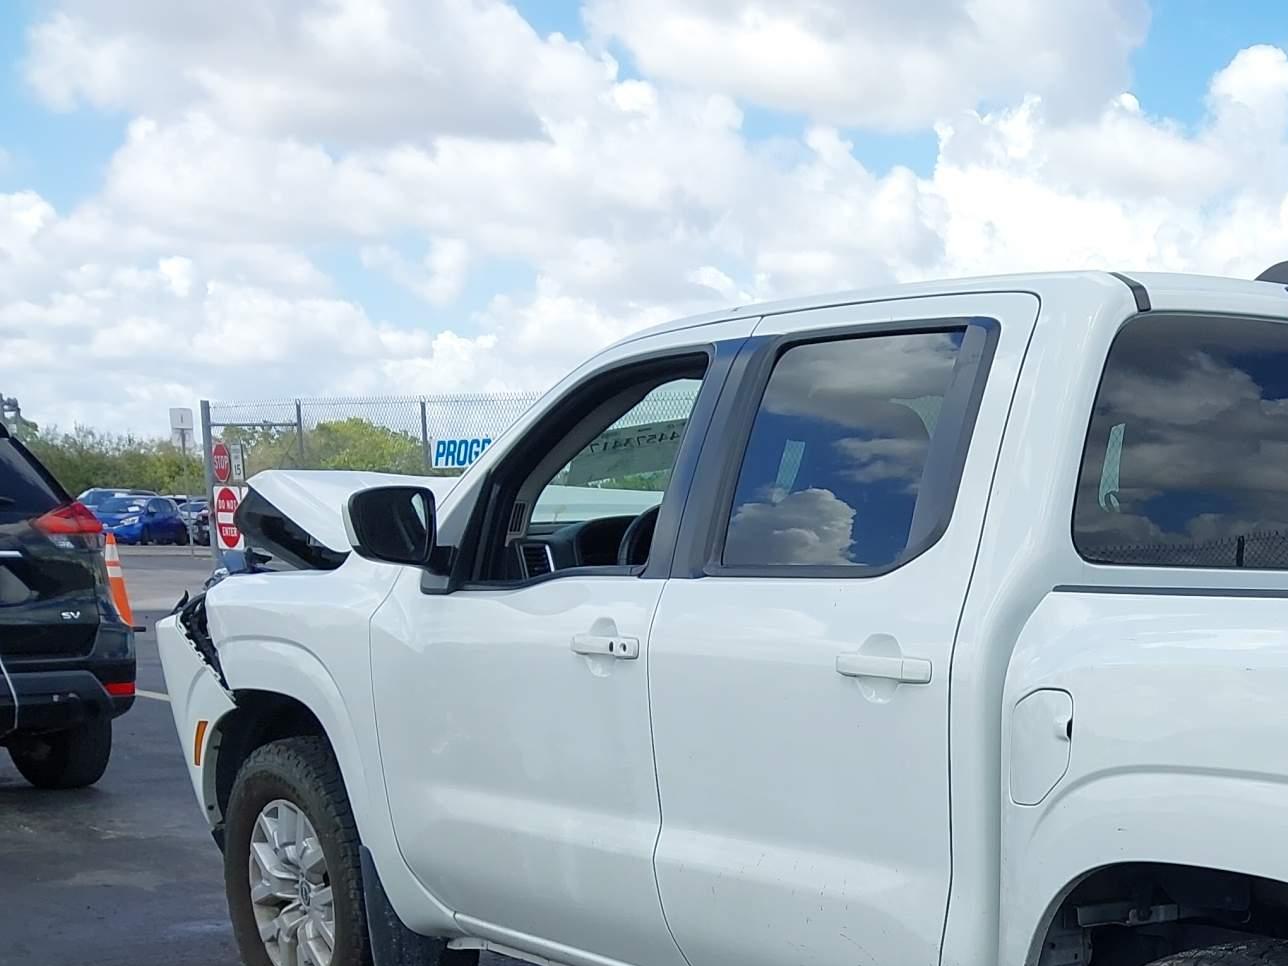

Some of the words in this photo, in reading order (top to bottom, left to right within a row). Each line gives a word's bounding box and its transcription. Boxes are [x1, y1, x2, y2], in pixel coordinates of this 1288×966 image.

[214, 456, 229, 469] STOP
[234, 463, 242, 475] 15
[218, 499, 226, 510] DO
[222, 526, 238, 536] ENTER
[61, 611, 81, 619] SV
